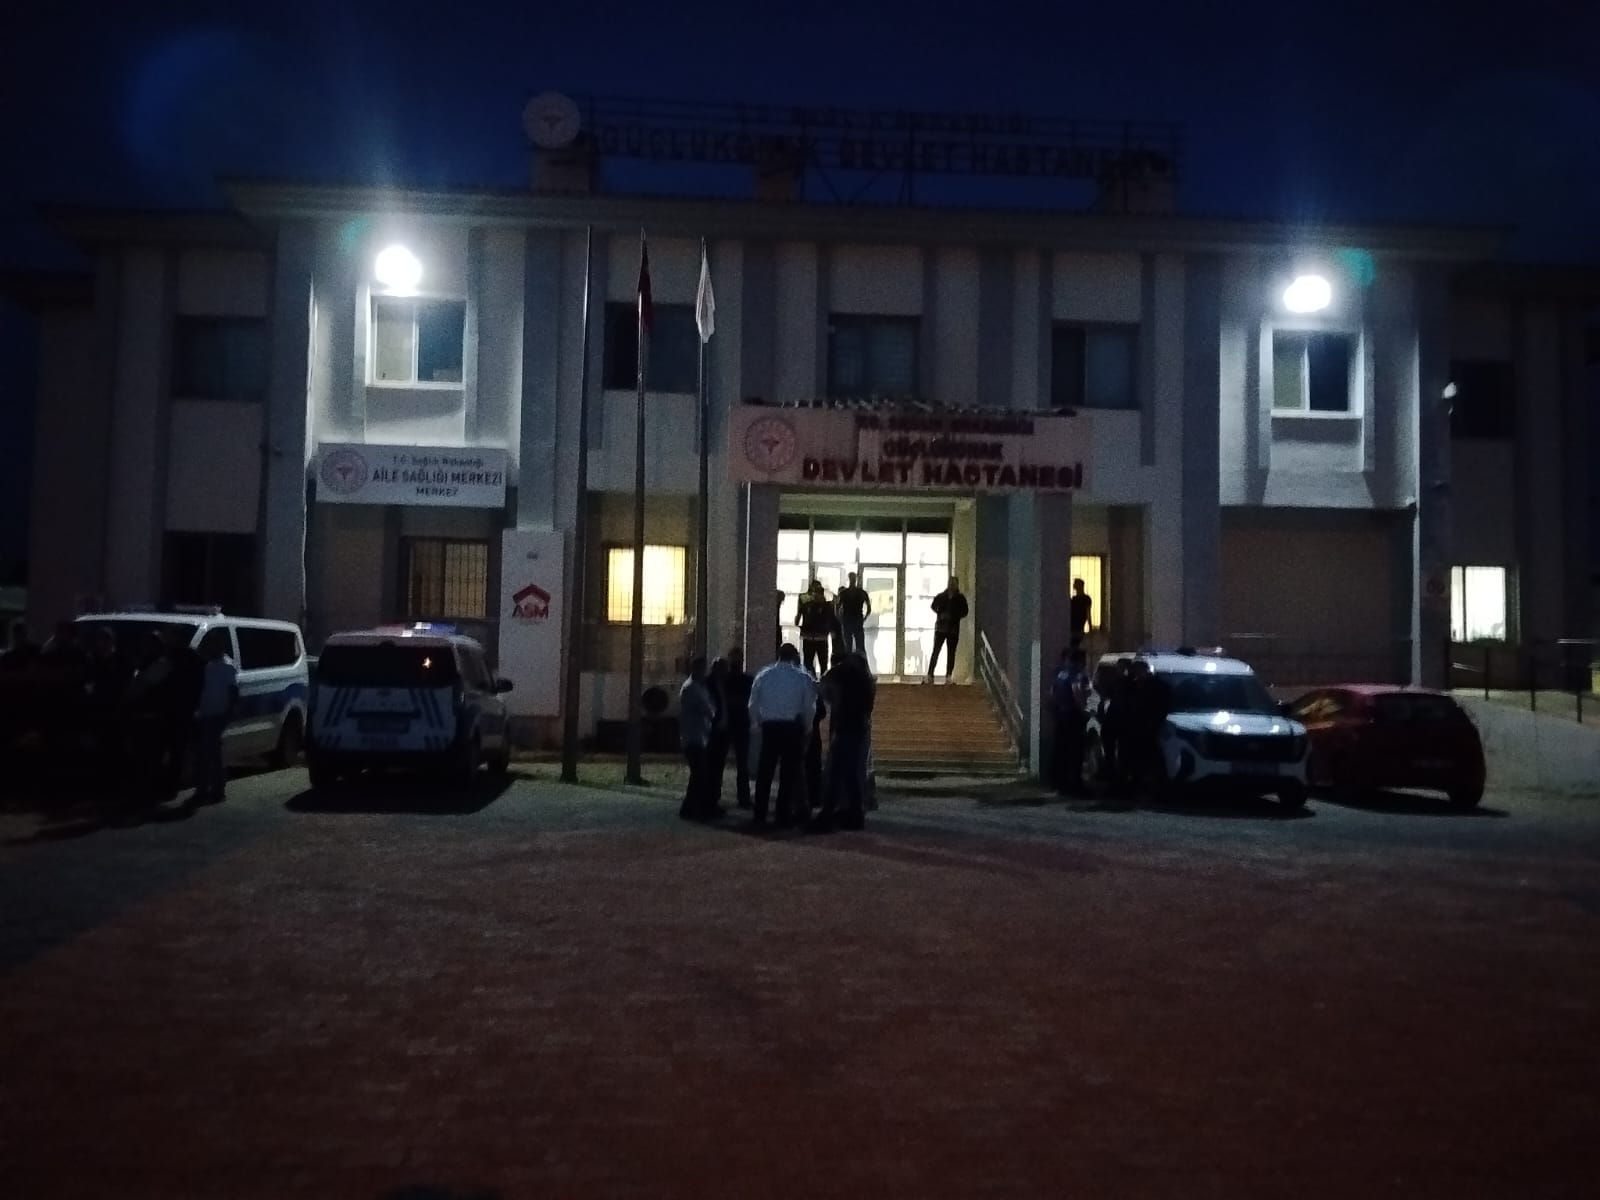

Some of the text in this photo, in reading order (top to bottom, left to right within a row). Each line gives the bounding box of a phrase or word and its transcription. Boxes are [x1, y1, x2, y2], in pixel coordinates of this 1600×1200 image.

[372, 467, 502, 487] AİLE SAĞLIĞI MERKEZİ
[802, 458, 909, 482] DEVLET
[415, 486, 458, 497] MERKEZ
